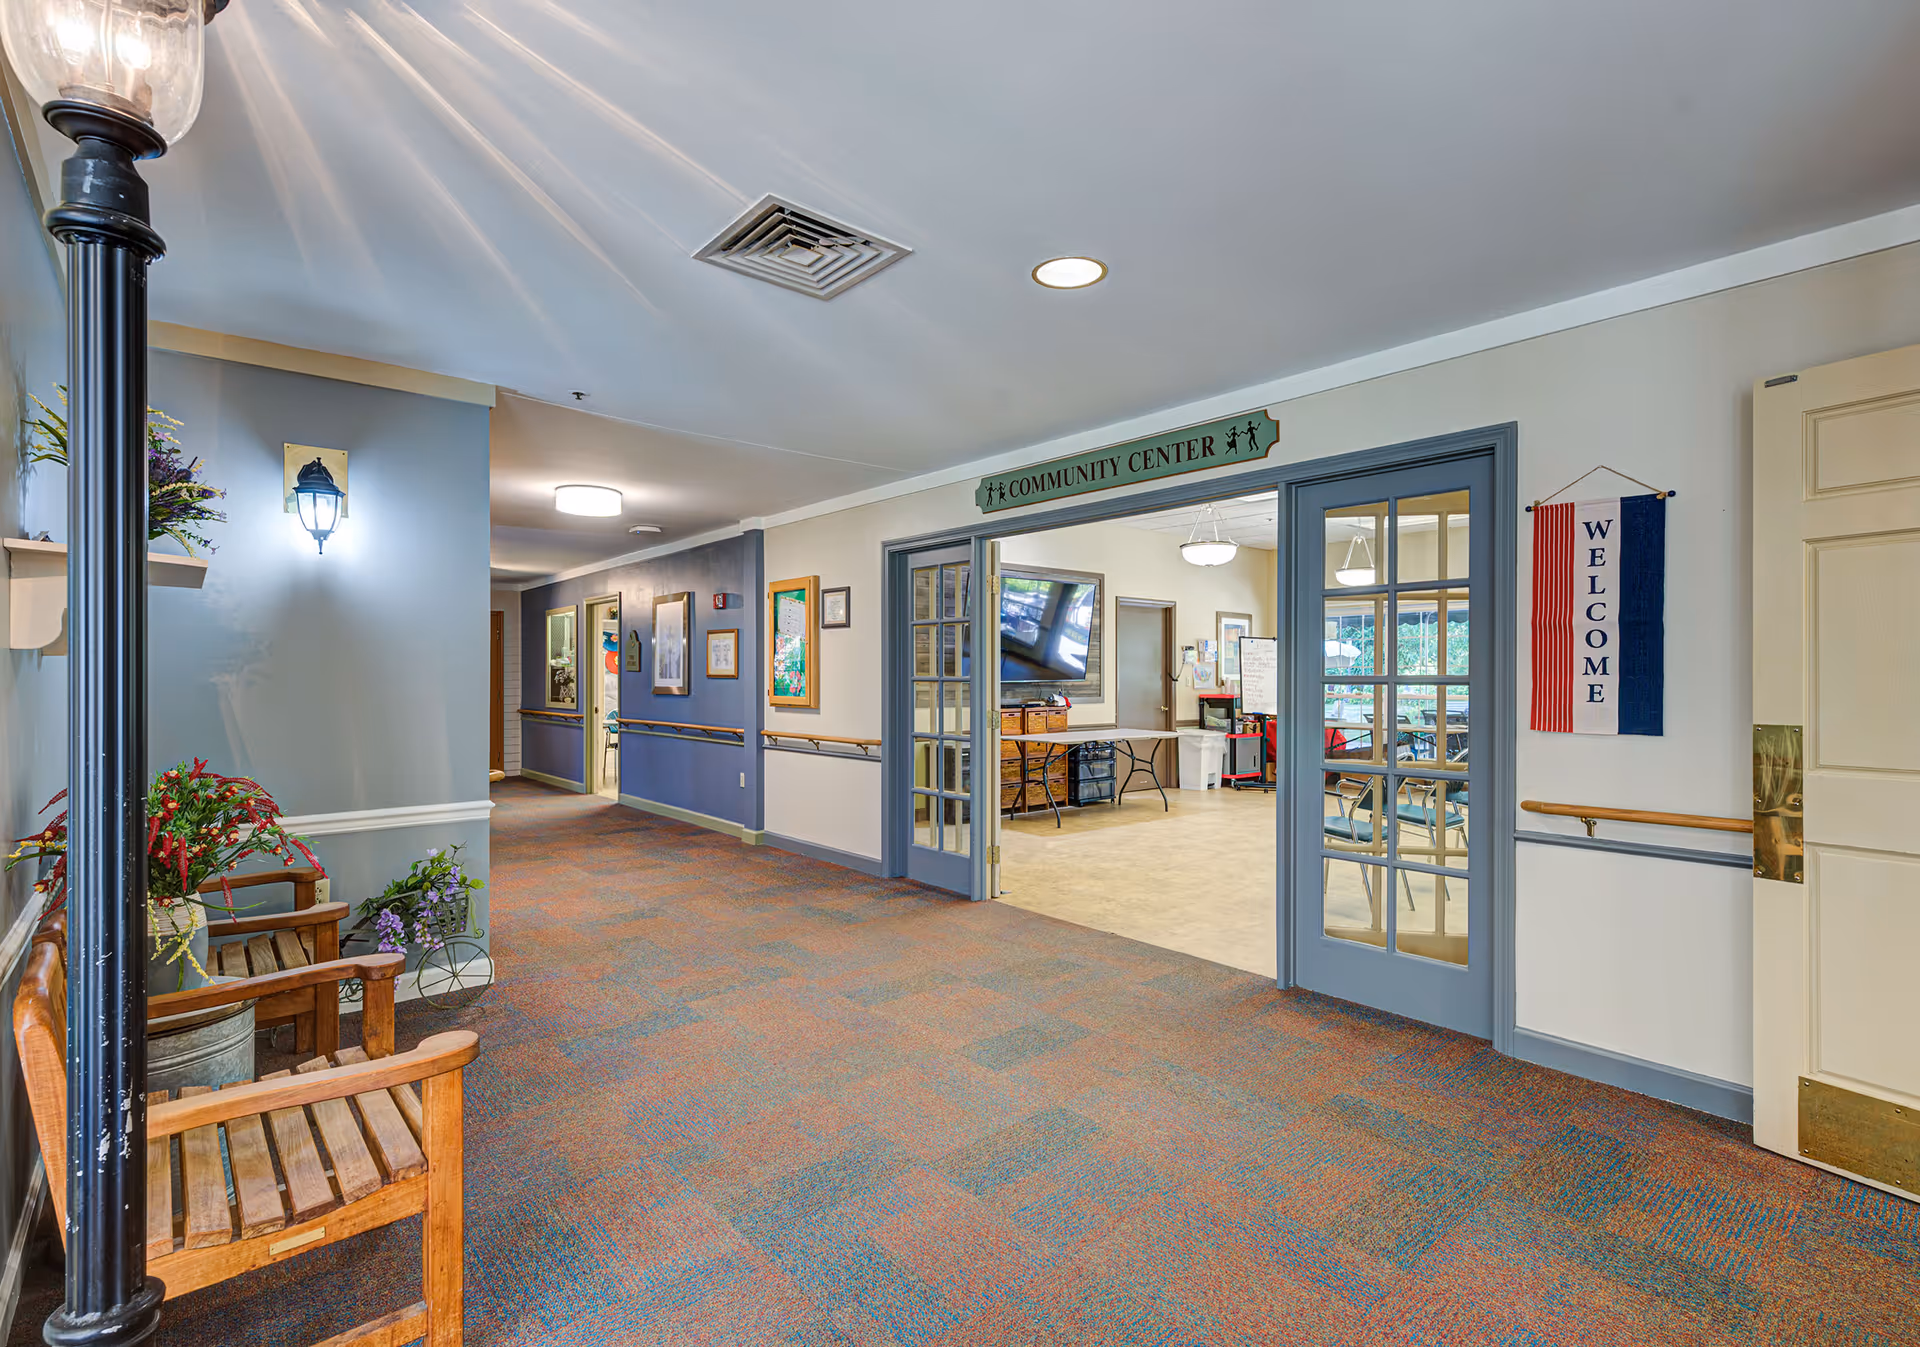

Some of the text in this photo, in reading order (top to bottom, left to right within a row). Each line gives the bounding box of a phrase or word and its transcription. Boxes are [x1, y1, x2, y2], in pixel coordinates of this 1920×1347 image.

[1008, 435, 1216, 499] COMMUNITY CENTER
[1582, 519, 1613, 703] WELCOME
